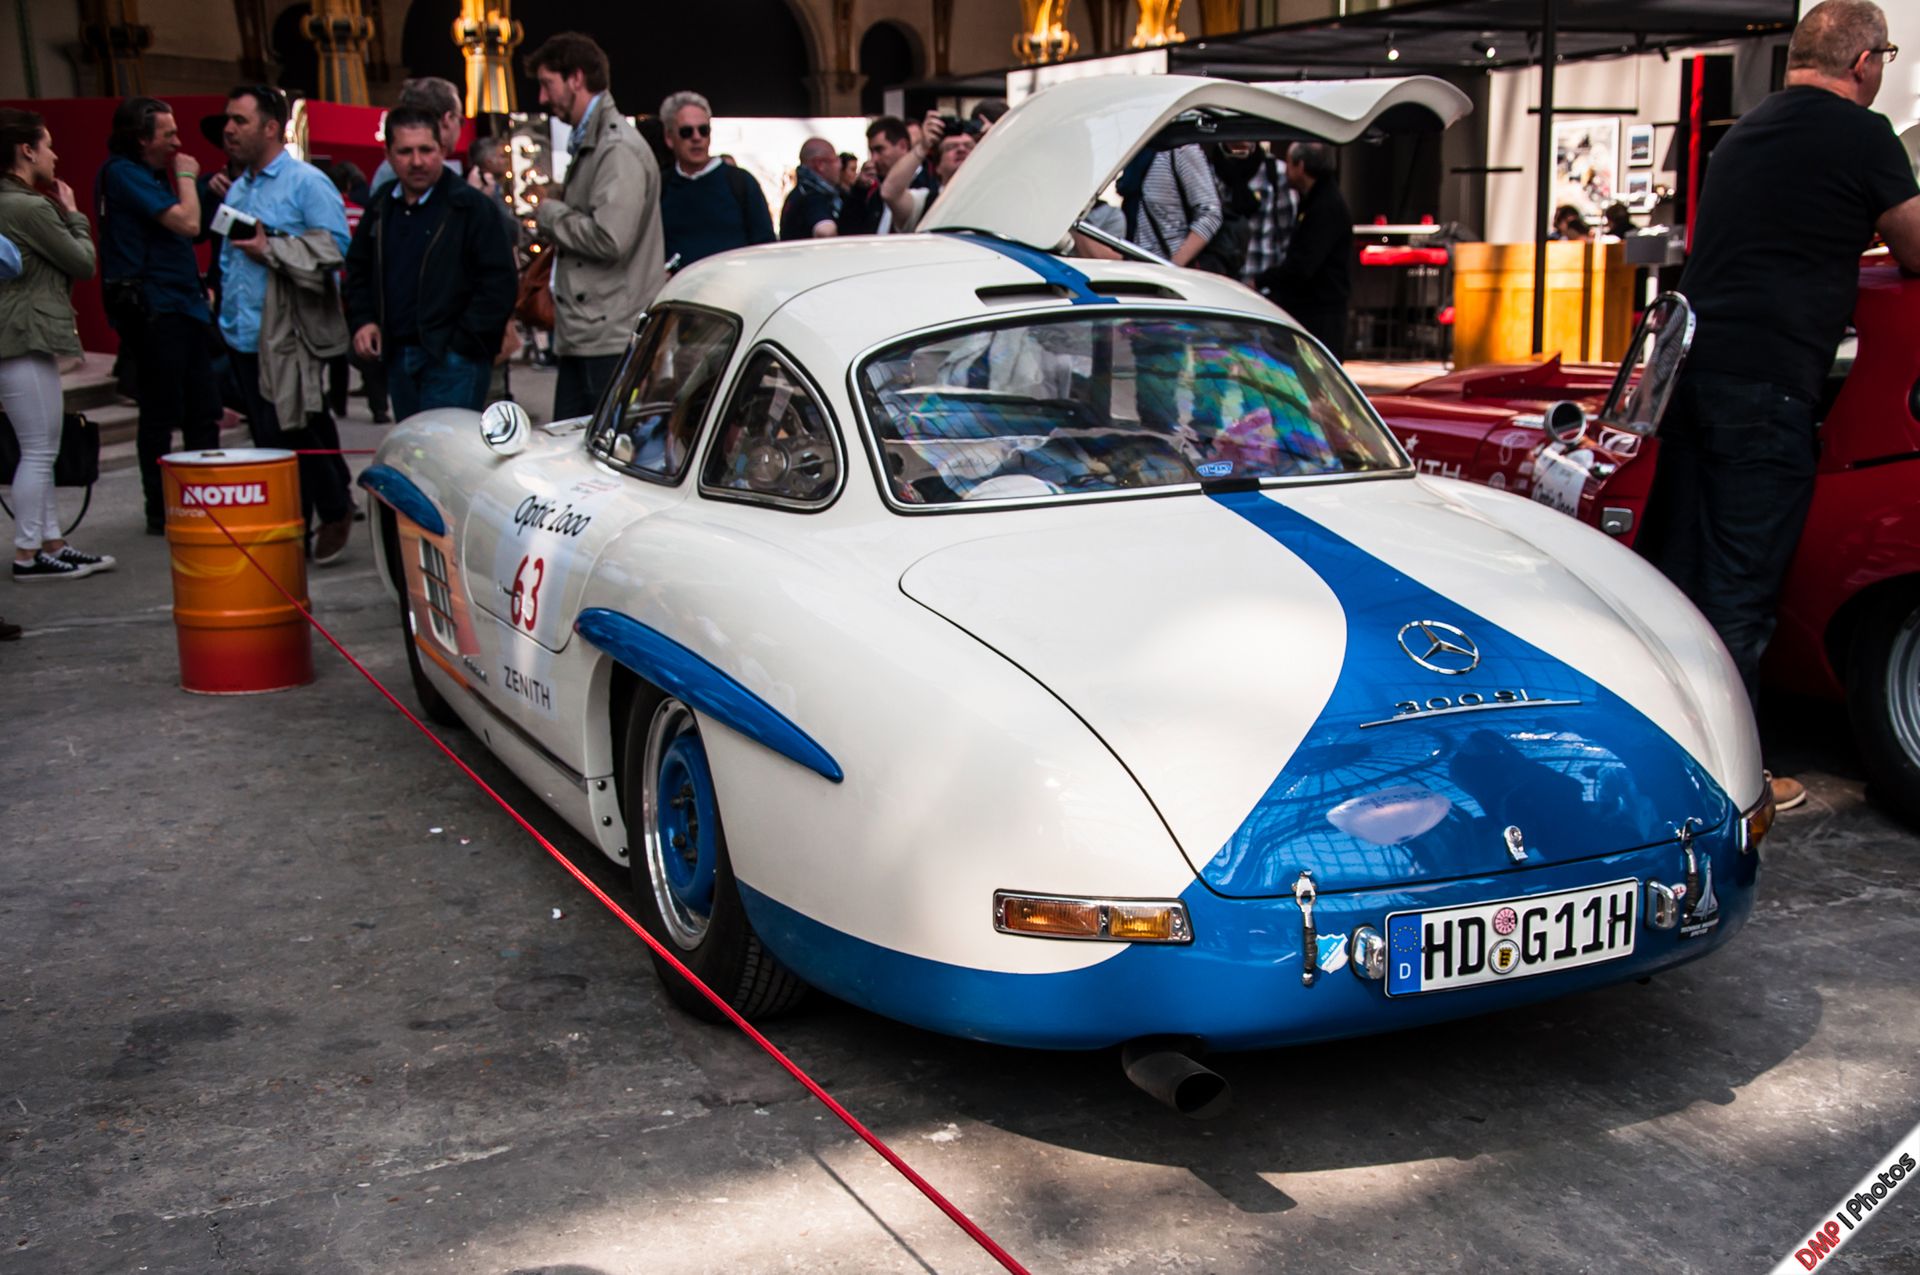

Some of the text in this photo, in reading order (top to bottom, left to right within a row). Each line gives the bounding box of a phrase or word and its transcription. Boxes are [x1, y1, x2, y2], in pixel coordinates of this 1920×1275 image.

[183, 484, 266, 505] MOTUL
[514, 494, 592, 537] Optic 2000
[511, 554, 545, 631] 63
[504, 665, 552, 711] ZENITH
[1395, 688, 1547, 716] 300 SL
[1423, 890, 1633, 980] HD G11H
[1399, 963, 1412, 980] D
